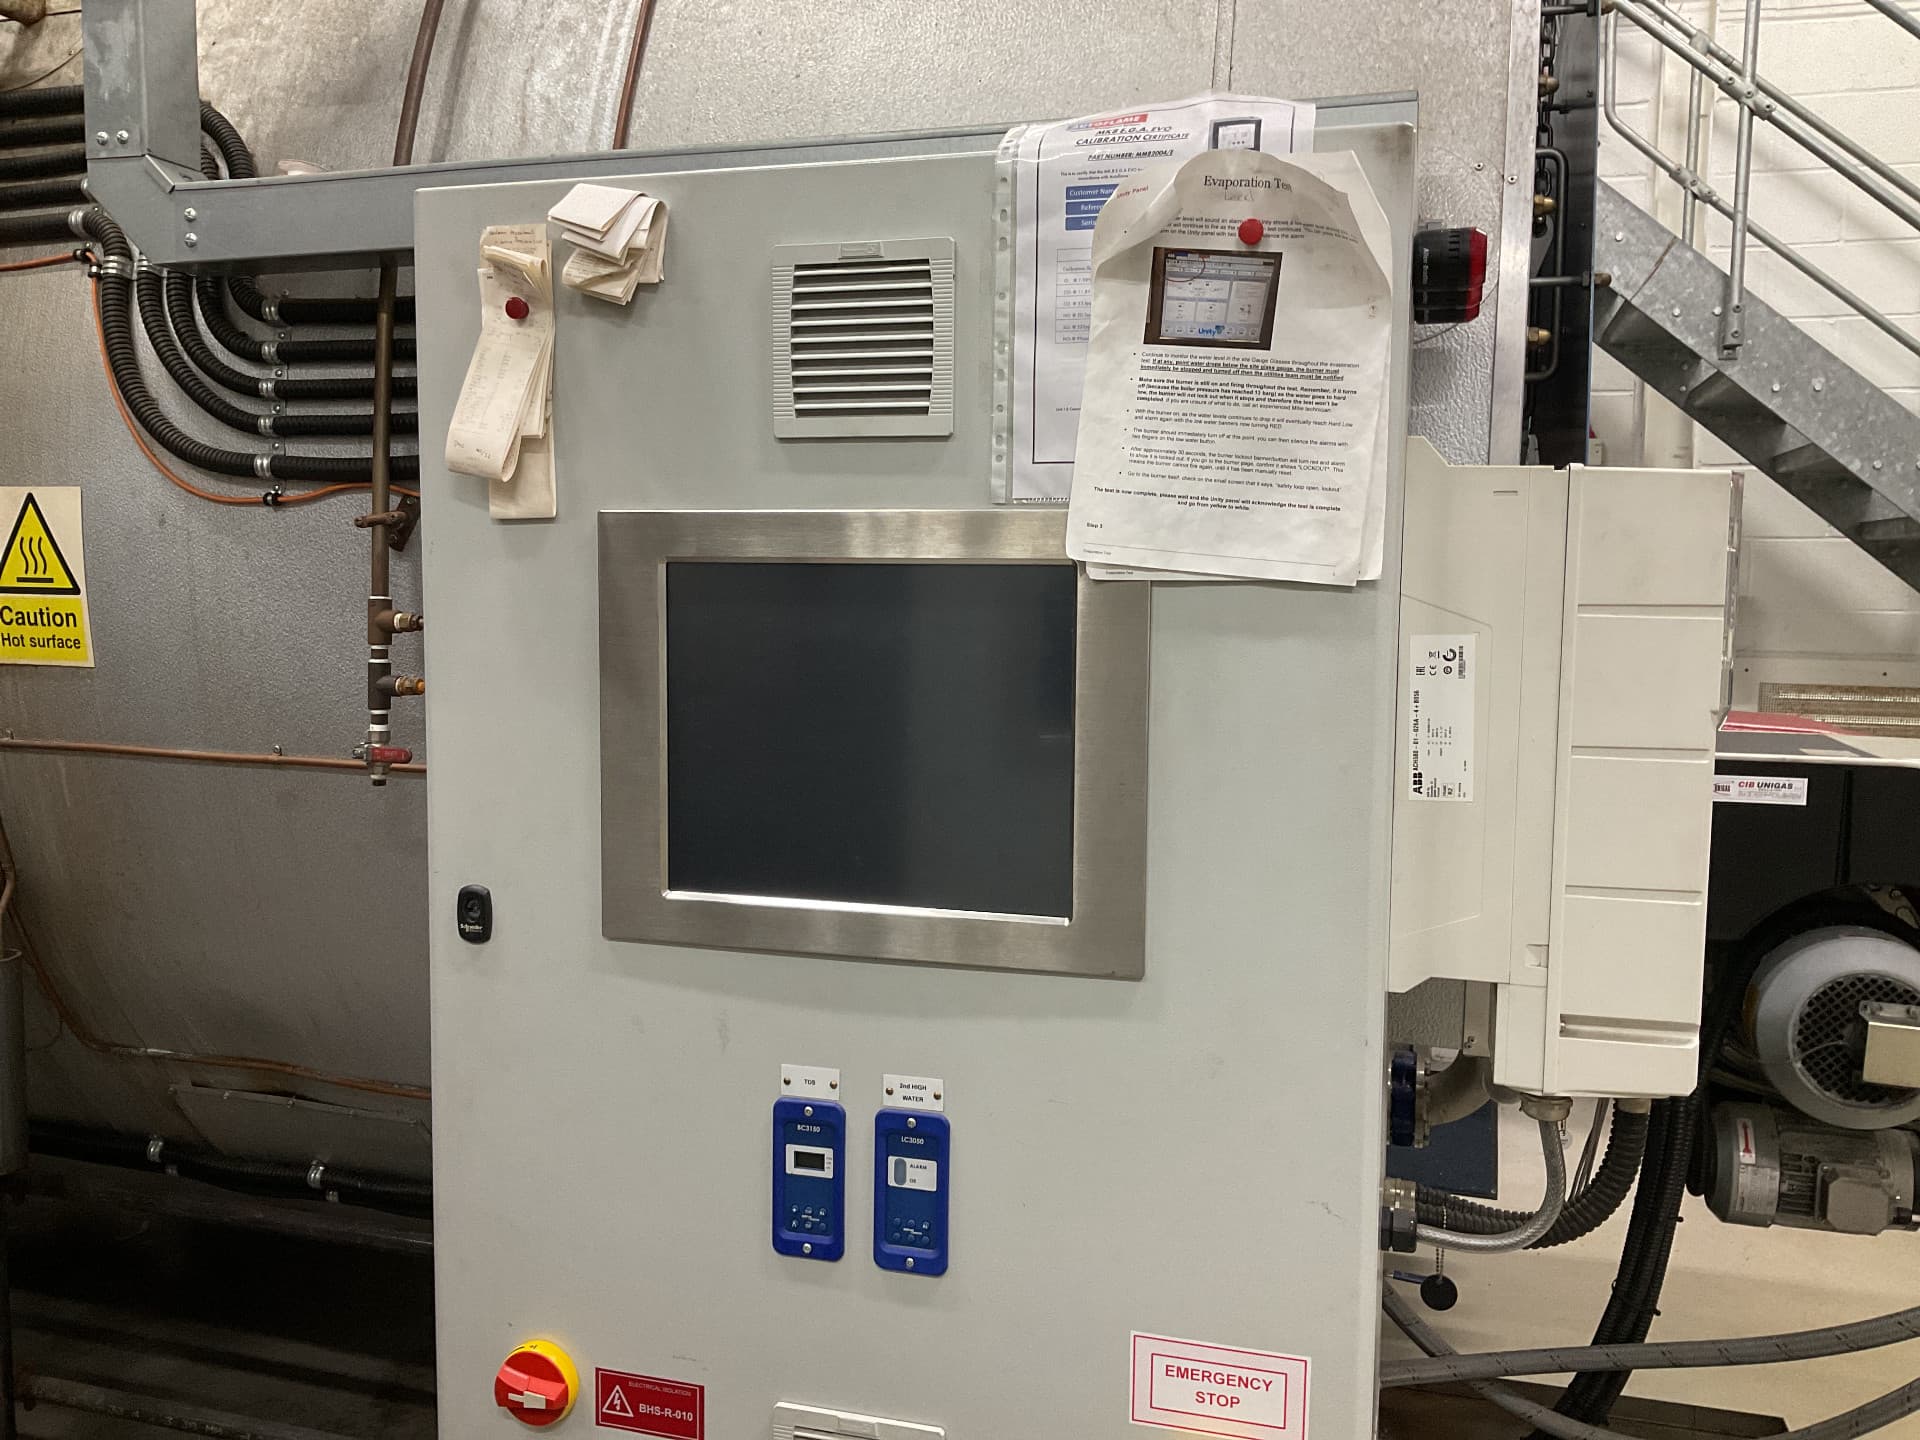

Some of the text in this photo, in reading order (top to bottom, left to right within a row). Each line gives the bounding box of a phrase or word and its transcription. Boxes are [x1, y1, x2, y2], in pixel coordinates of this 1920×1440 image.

[1076, 133, 1190, 146] CALIBRATION CERTIFICATE
[1132, 184, 1148, 193] Panel
[1204, 176, 1270, 190] Evaporation
[1251, 499, 1286, 507] acknowledge
[0, 606, 77, 628] Caution
[1, 633, 80, 649] Hot surface
[1413, 772, 1423, 794] ABB
[797, 1124, 821, 1133] BC3150
[901, 1136, 924, 1145] LC3050
[1165, 1364, 1273, 1392] EMERGENCY
[628, 1381, 692, 1396] ELECTRICAL ISOLATION
[1195, 1391, 1240, 1408] STOP
[639, 1403, 693, 1422] BHS-R-010
